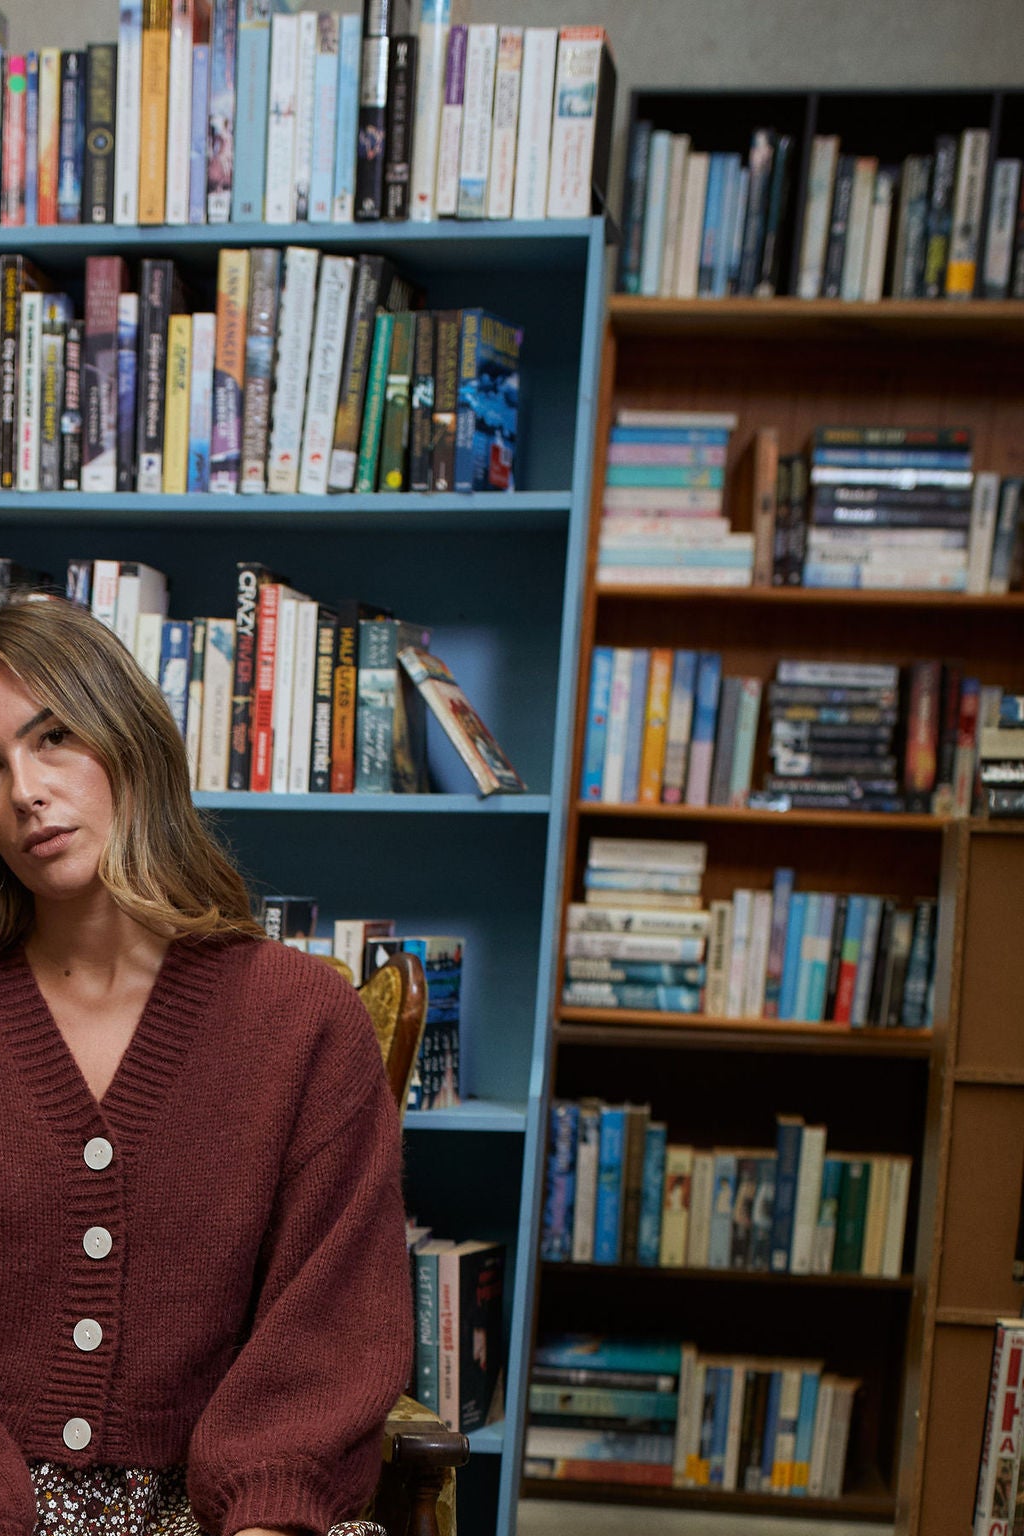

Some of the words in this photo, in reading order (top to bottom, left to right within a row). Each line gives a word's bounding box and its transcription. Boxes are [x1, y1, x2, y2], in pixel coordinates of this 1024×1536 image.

[237, 570, 258, 636] CRAZY
[339, 628, 354, 666] HALF
[317, 656, 333, 697] GRANT
[420, 1267, 433, 1292] LET
[420, 1295, 432, 1308] IT
[419, 1310, 432, 1345] SNOW
